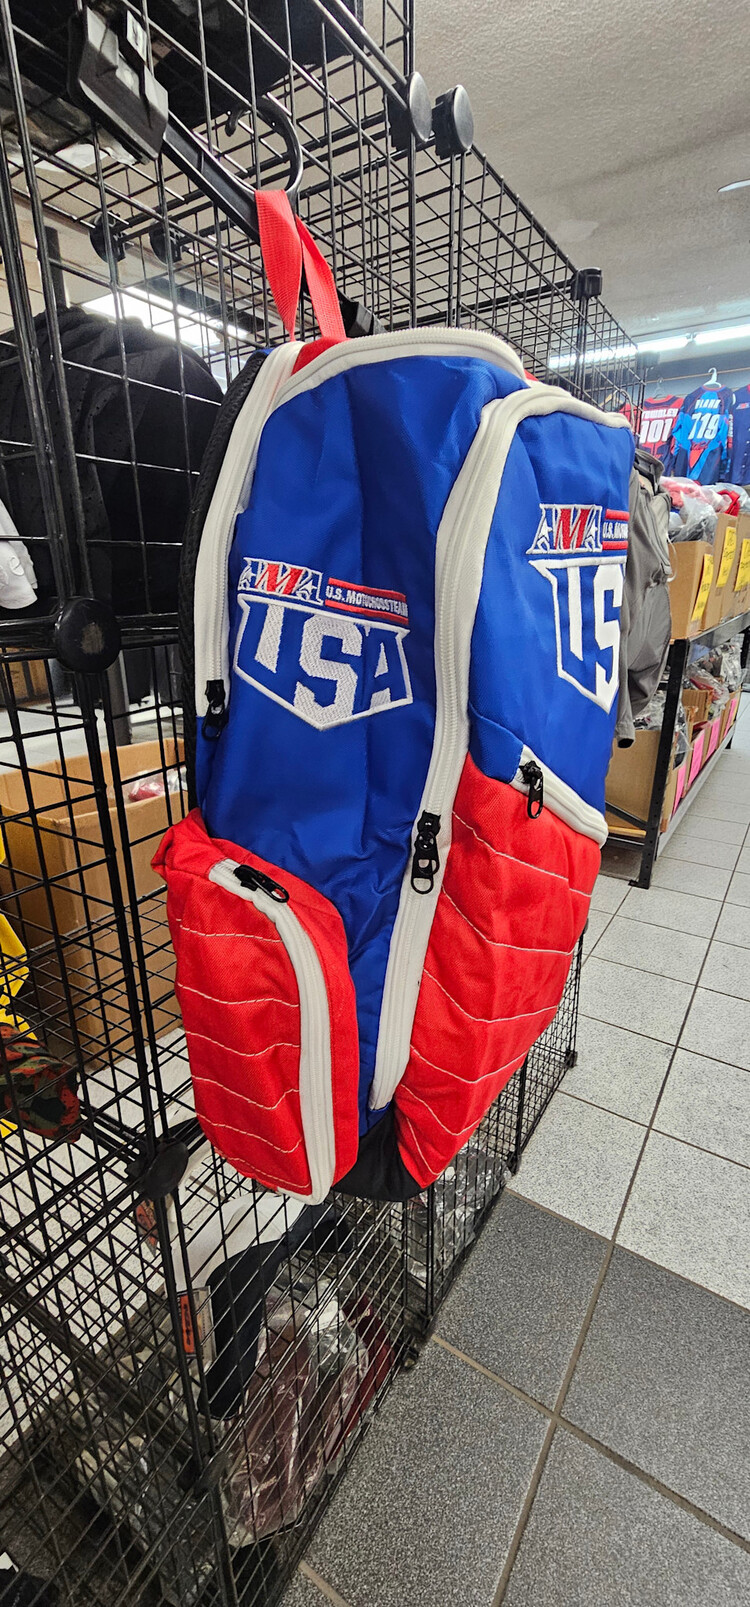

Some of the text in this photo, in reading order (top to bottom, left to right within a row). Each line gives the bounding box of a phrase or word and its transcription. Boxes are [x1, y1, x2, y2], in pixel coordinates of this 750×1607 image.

[639, 418, 673, 444] 101
[688, 412, 721, 440] 719
[526, 503, 603, 555] AMA
[237, 556, 324, 606] AMA
[325, 585, 345, 603] U.S.
[235, 598, 412, 727] USA
